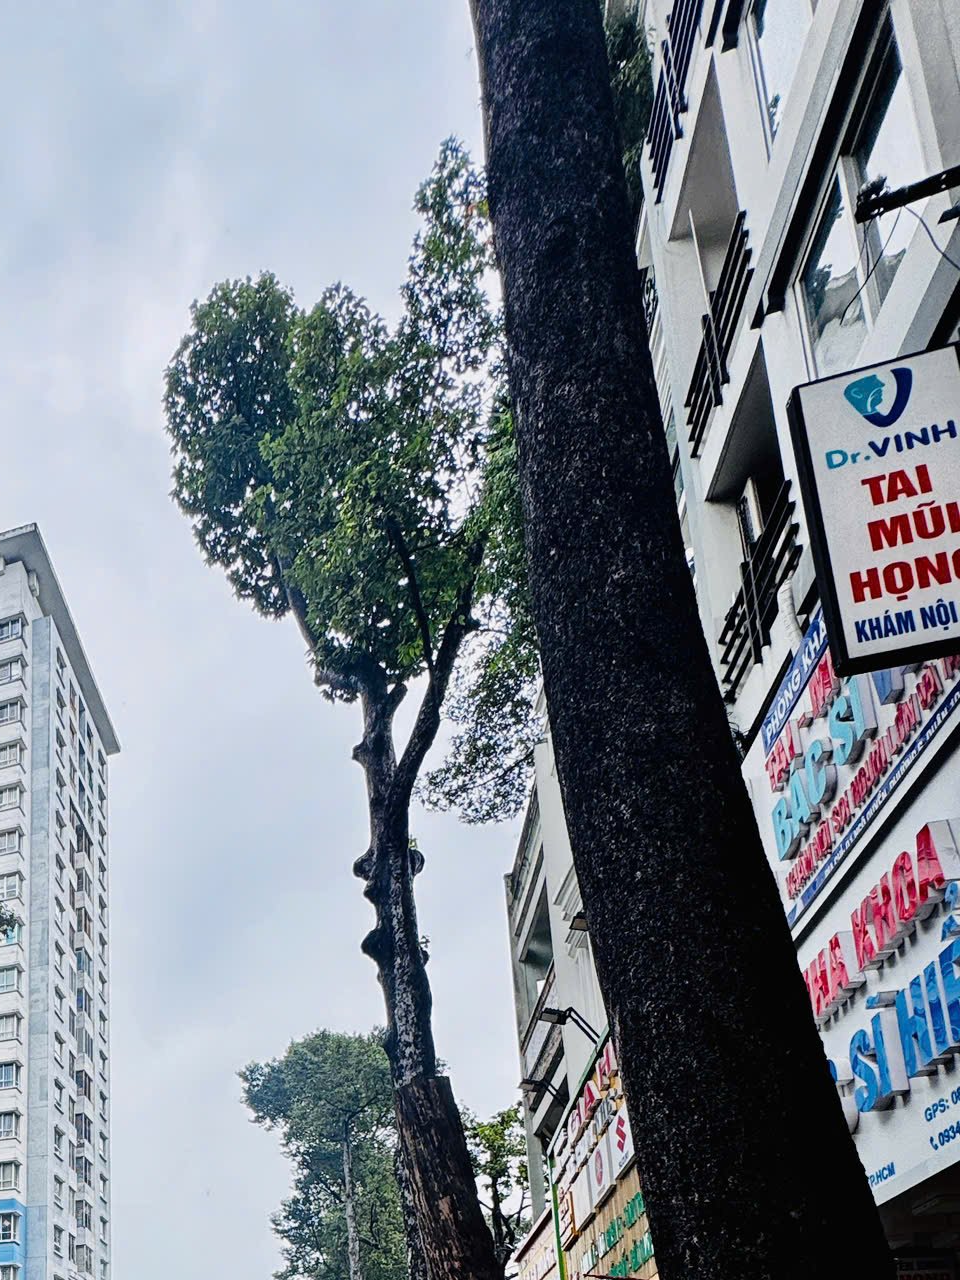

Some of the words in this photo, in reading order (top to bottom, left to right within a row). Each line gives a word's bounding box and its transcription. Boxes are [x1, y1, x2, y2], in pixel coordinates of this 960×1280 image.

[861, 464, 933, 506] TAI
[854, 609, 916, 643] KHÁM
[919, 598, 959, 631] NỘI
[765, 668, 802, 746] PHÒNG
[804, 932, 850, 1017] HA
[851, 823, 945, 972] KHOA
[868, 1163, 896, 1187] P.HCM
